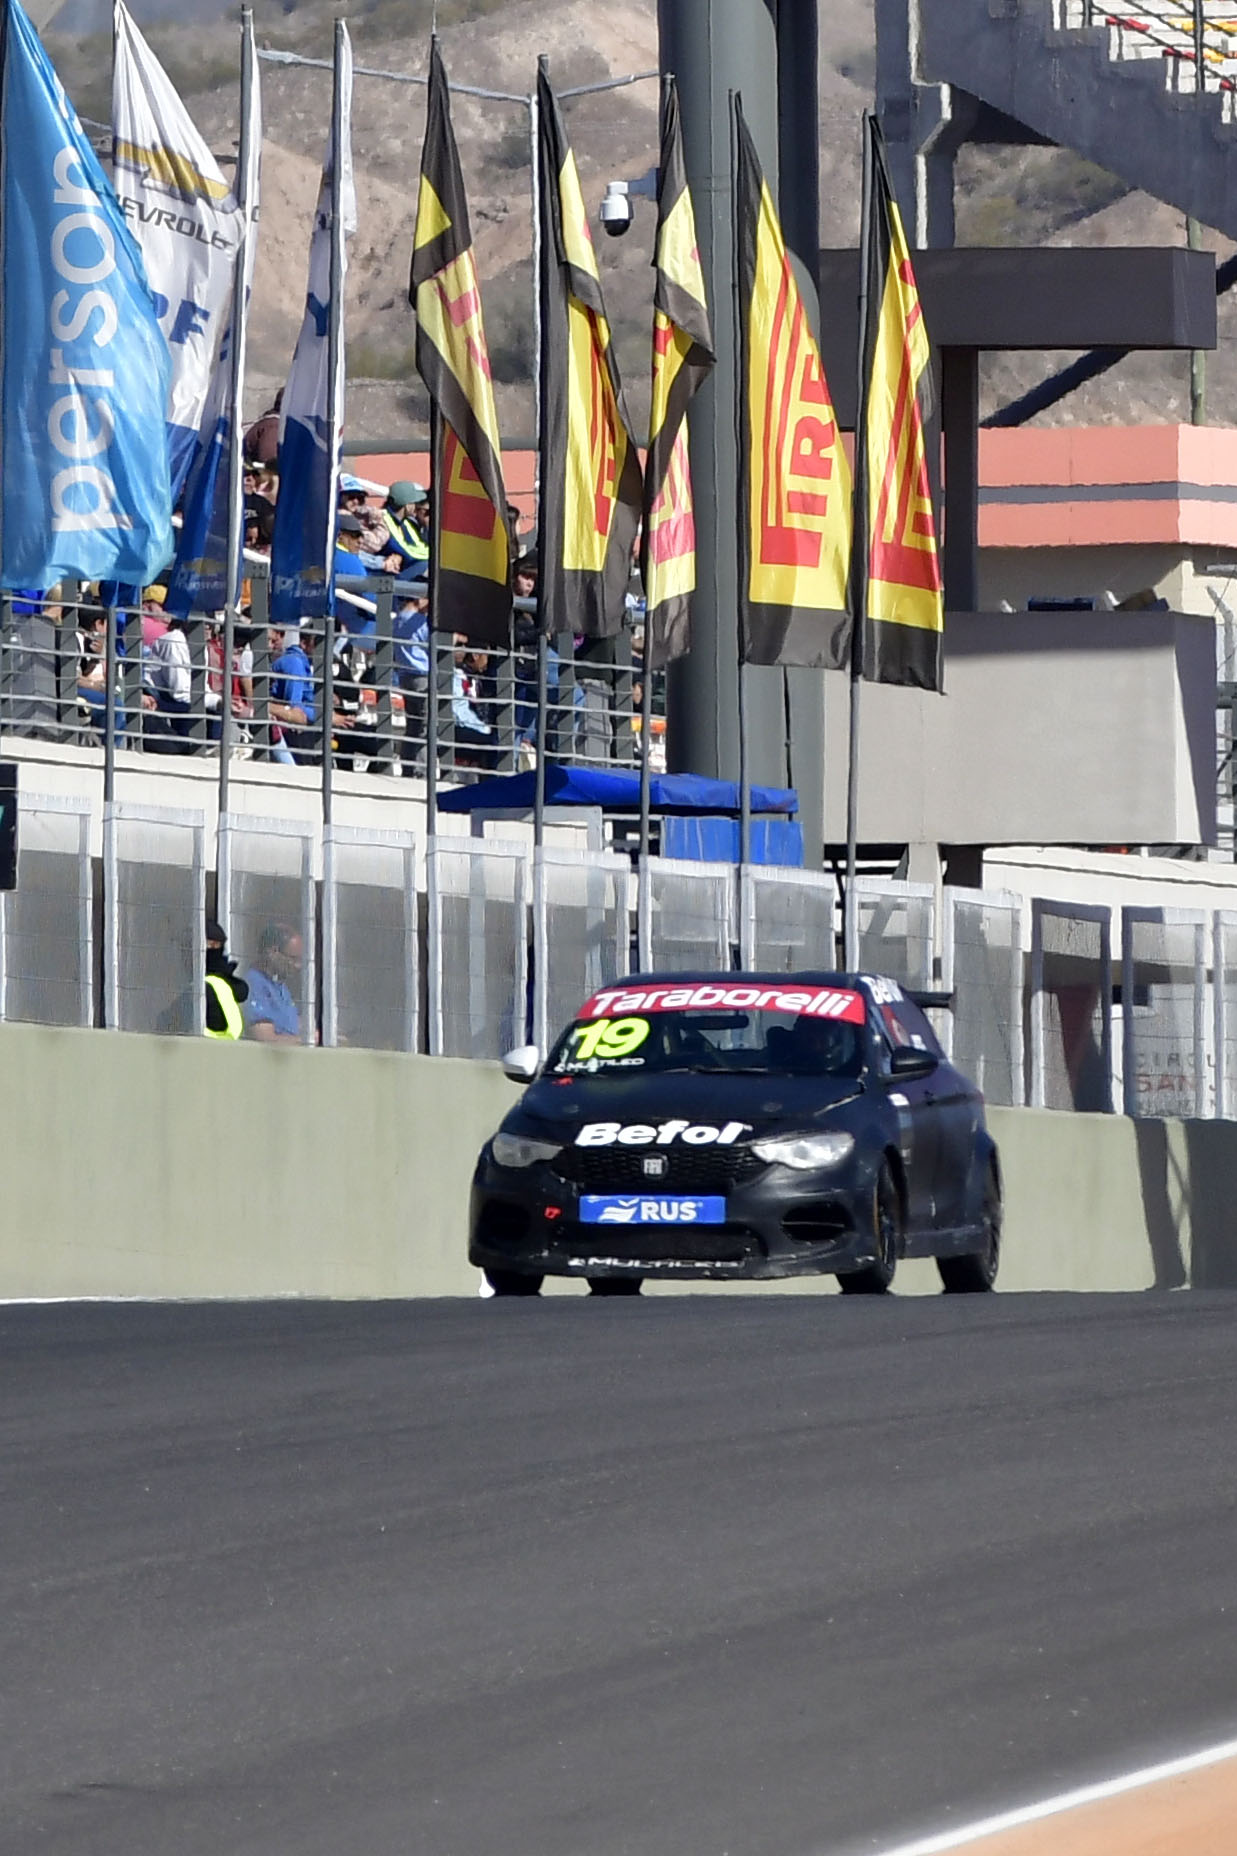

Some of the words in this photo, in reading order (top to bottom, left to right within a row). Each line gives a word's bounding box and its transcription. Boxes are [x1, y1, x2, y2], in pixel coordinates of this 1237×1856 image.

[47, 122, 133, 532] person
[591, 985, 854, 1016] Taraborelli
[574, 1017, 651, 1059] 19
[575, 1119, 744, 1146] Befol
[641, 1201, 698, 1221] RUS
